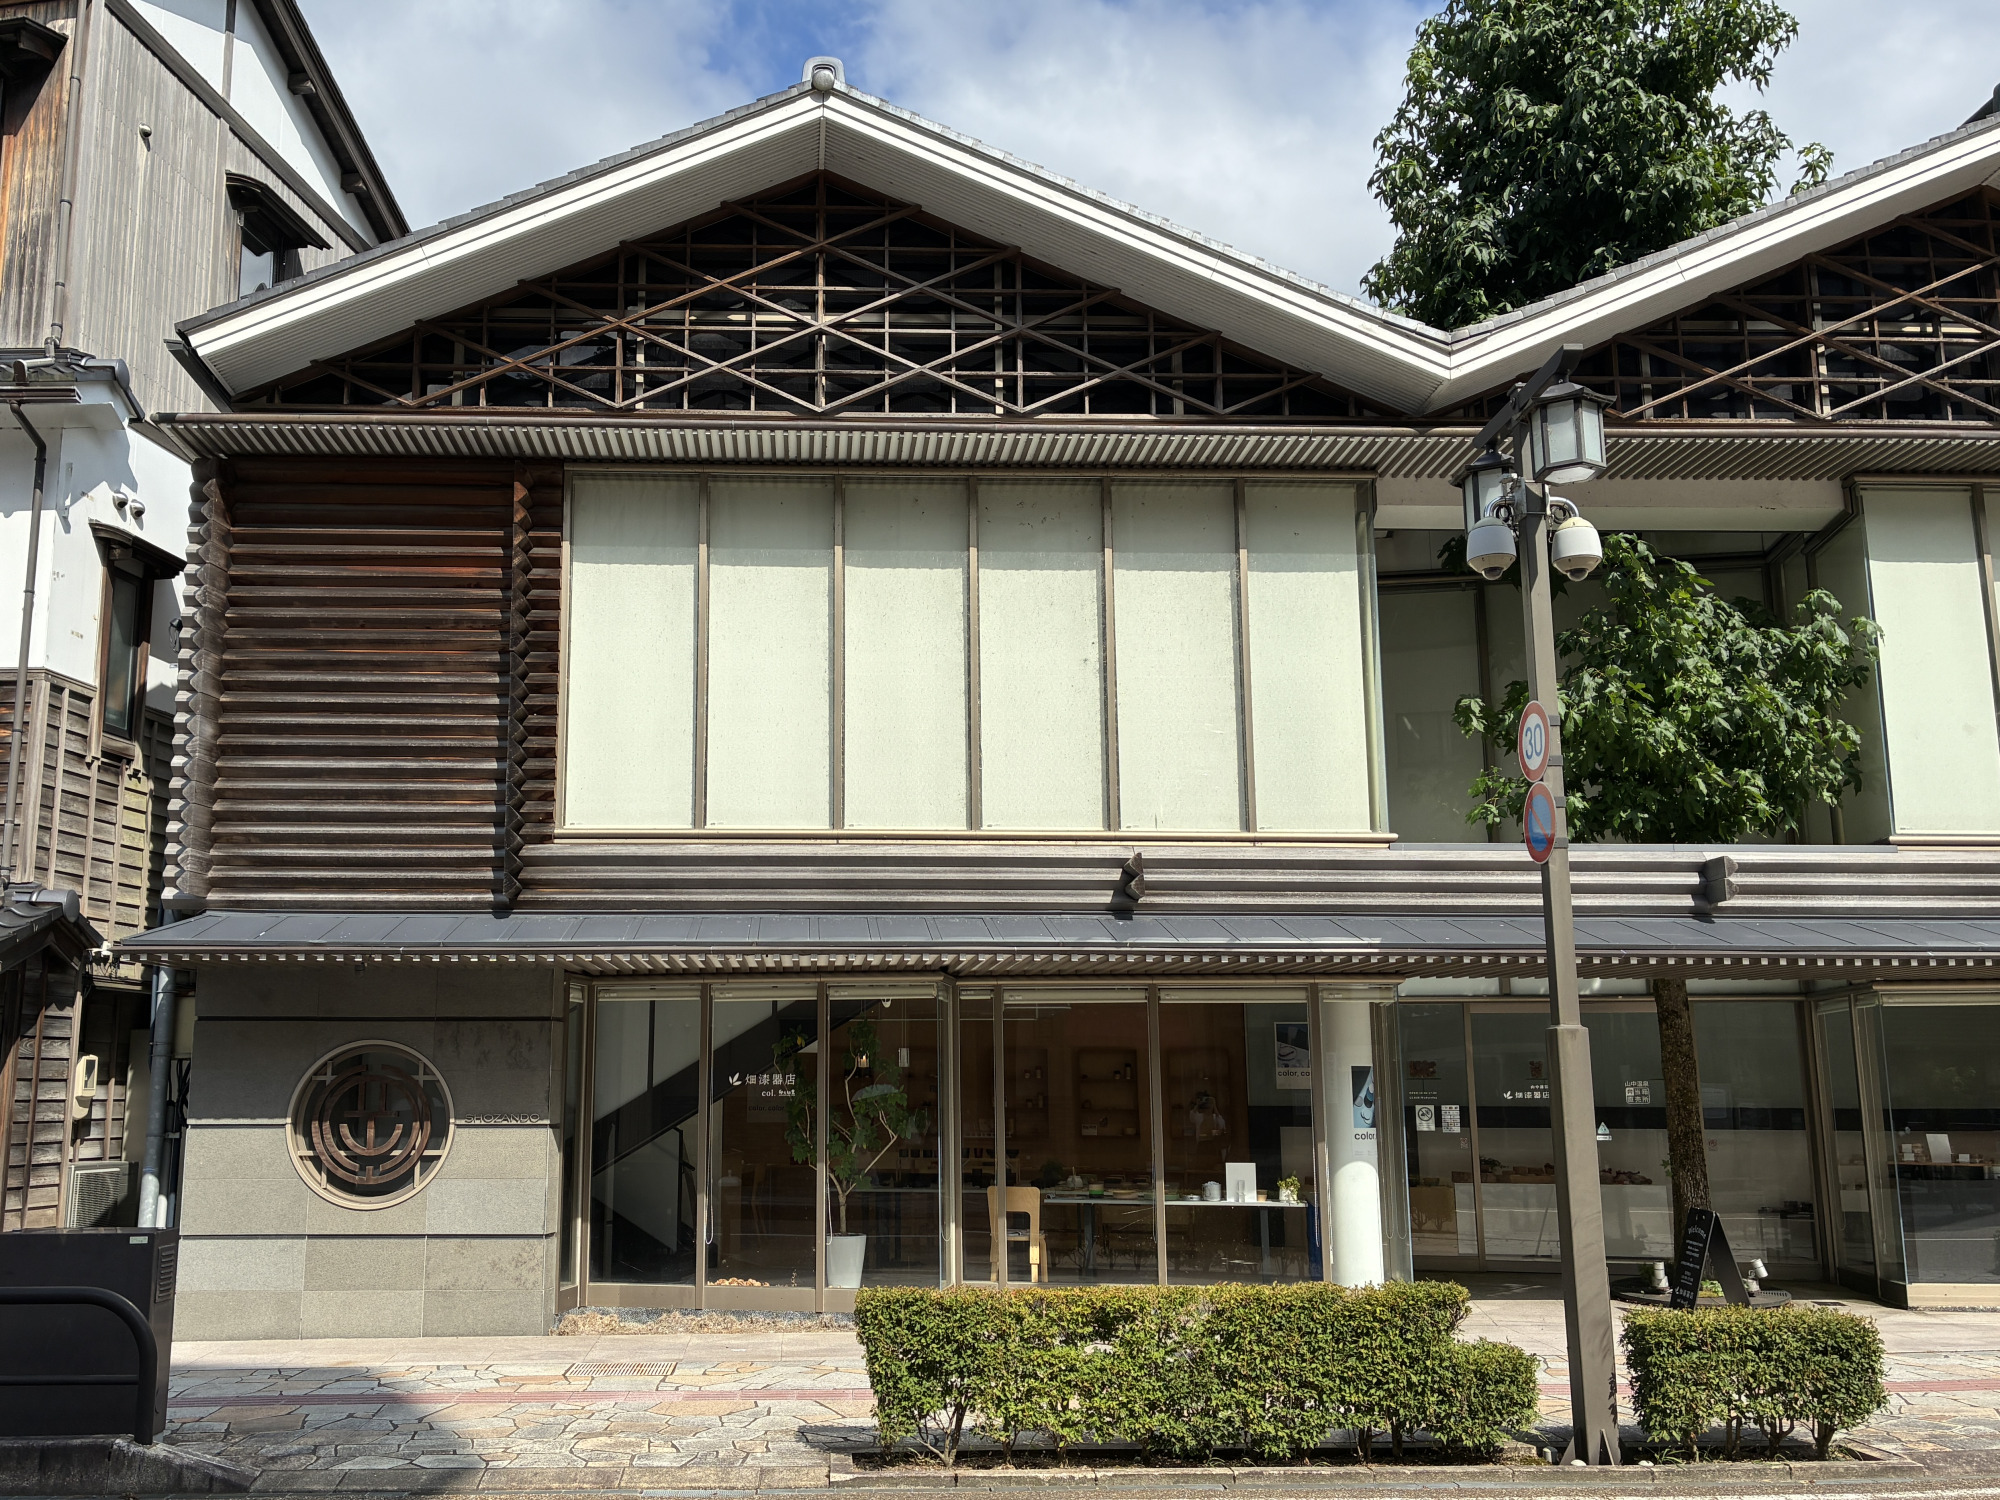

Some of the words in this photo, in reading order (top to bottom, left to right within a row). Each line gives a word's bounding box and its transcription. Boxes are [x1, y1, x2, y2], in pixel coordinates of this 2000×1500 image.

[1525, 723, 1543, 760] 30
[745, 1073, 796, 1085] 畑漆器店
[464, 1113, 540, 1123] SHOZANDO
